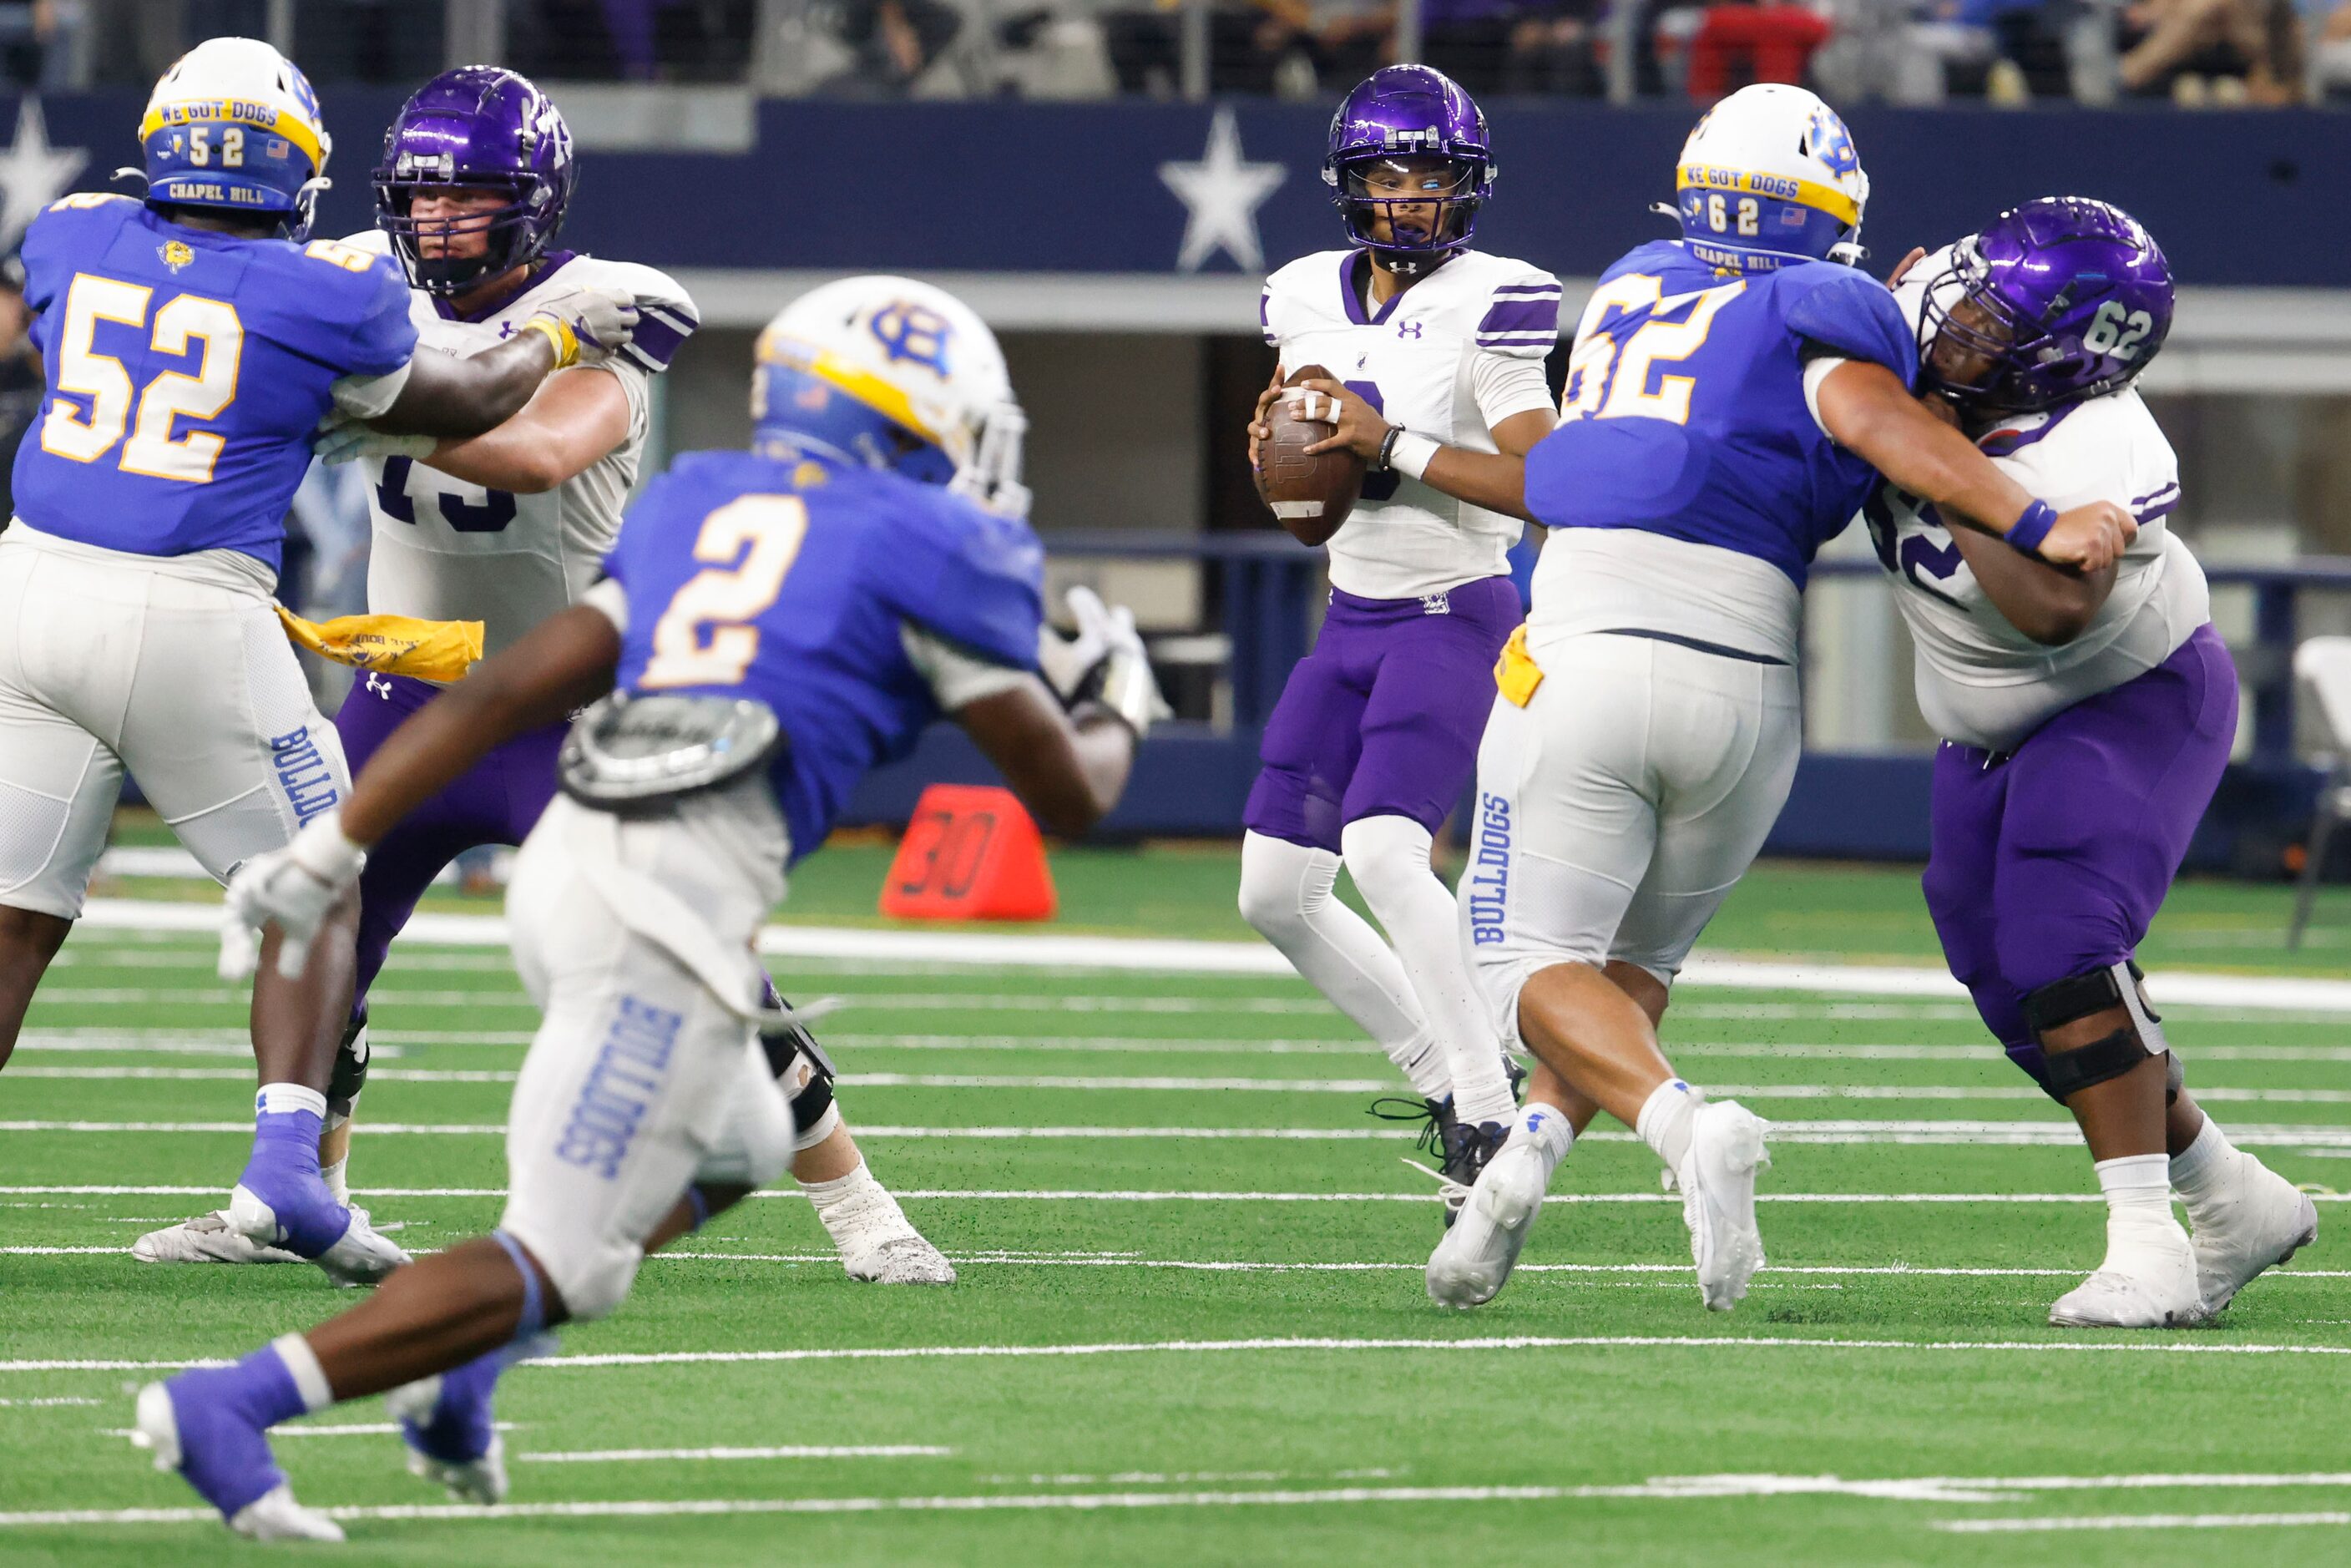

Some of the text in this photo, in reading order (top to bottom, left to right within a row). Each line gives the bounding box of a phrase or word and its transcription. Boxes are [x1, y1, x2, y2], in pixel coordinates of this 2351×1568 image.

[161, 101, 278, 127] WE GOT DOGS
[169, 183, 265, 205] CHAPEL HILL
[1686, 166, 1800, 199] WE GOT DOGS
[1692, 245, 1783, 271] CHAPEL HILL
[1554, 273, 1747, 430] 62
[2083, 300, 2152, 362] 62
[40, 271, 245, 483] 52
[638, 493, 808, 689] 2
[271, 725, 338, 829] BULLD
[1470, 792, 1513, 947] BULLDOGS
